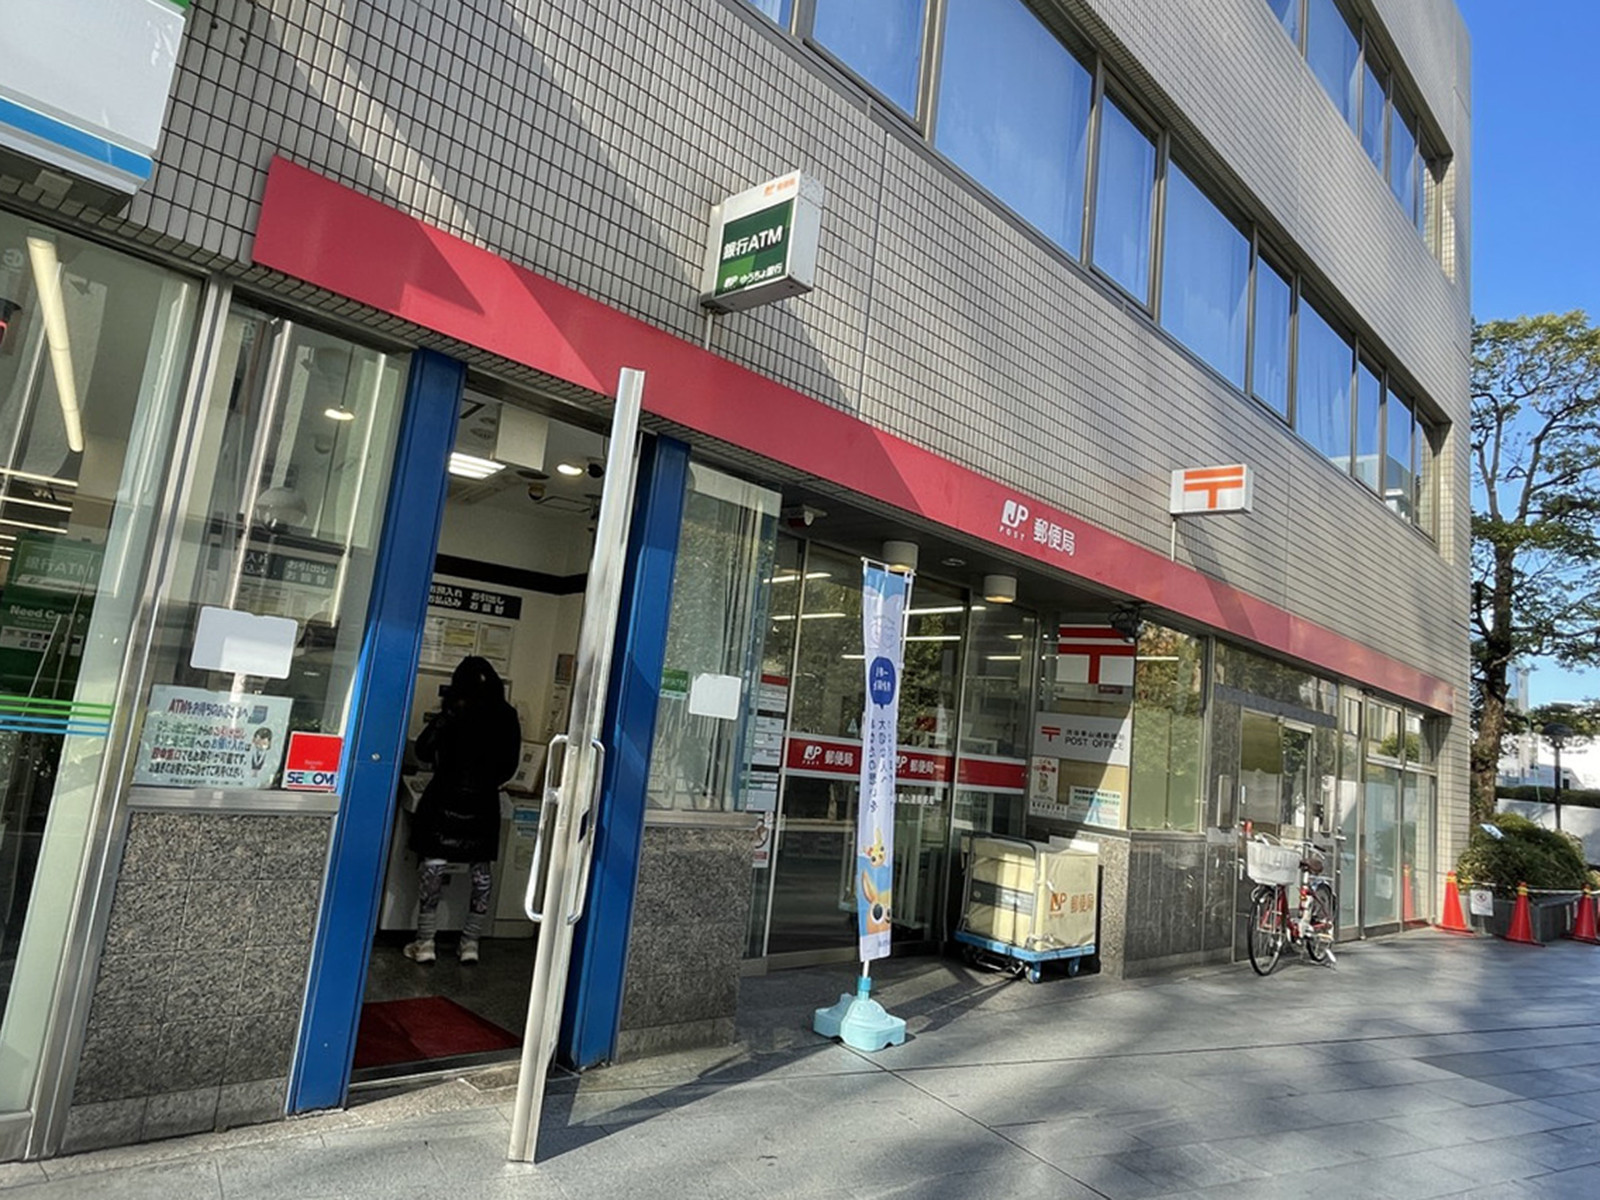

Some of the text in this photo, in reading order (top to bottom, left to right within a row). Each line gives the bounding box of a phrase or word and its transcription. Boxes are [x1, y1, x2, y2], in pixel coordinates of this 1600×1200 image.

[722, 225, 783, 259] 銀行ATM
[1033, 517, 1076, 556] 郵便局
[471, 592, 505, 605] お引出し
[10, 605, 42, 618] Need
[1065, 736, 1124, 750] POST OFFICE
[824, 750, 854, 767] 郵便局
[910, 759, 934, 774] 郵便局
[287, 771, 335, 785] SECOM
